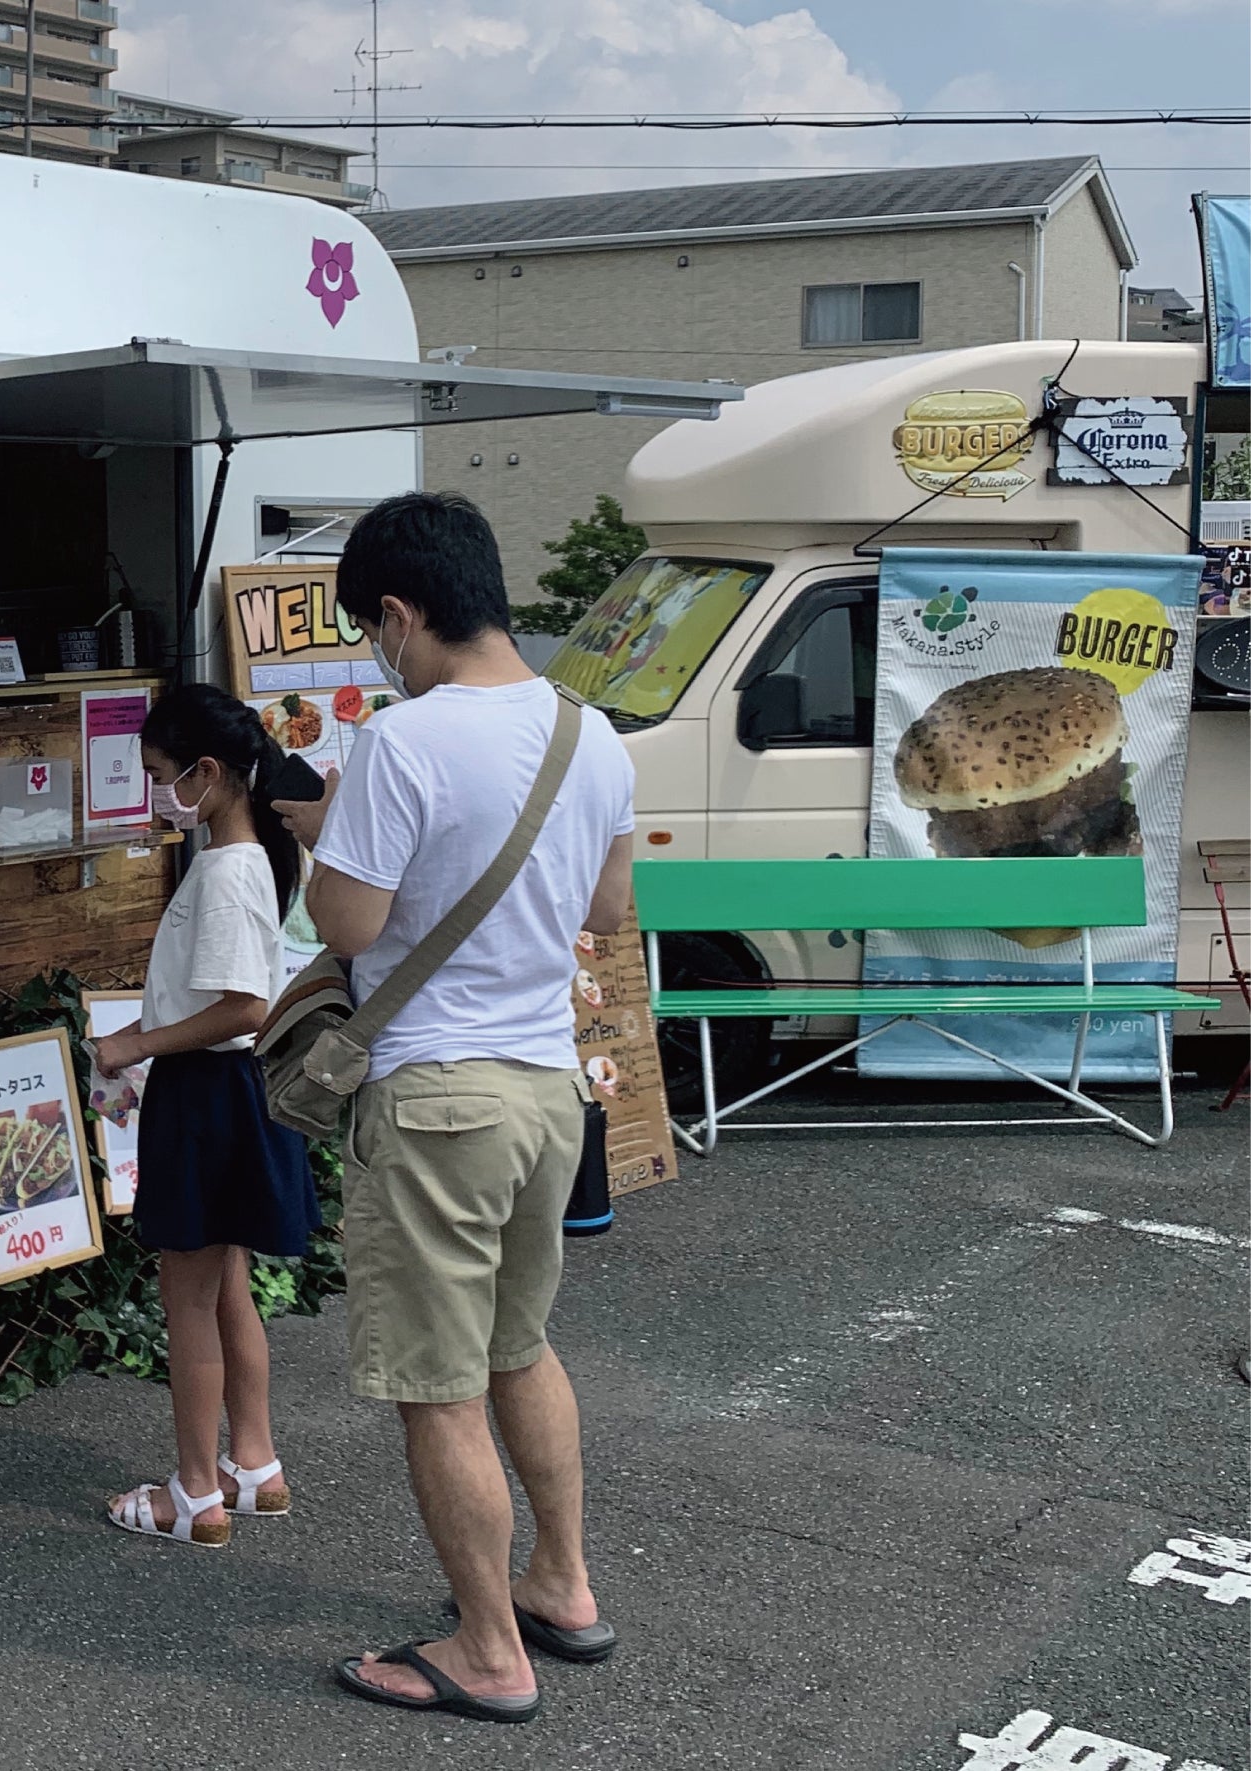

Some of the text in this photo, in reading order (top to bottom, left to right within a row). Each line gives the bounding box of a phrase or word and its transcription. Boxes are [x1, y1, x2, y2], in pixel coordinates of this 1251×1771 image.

[1076, 427, 1170, 458] Corona
[1103, 452, 1151, 469] Extra
[967, 473, 1026, 488] Delicious
[1053, 611, 1179, 672] BURGER
[1109, 1017, 1144, 1036] yen
[6, 1225, 64, 1261] 400 円
